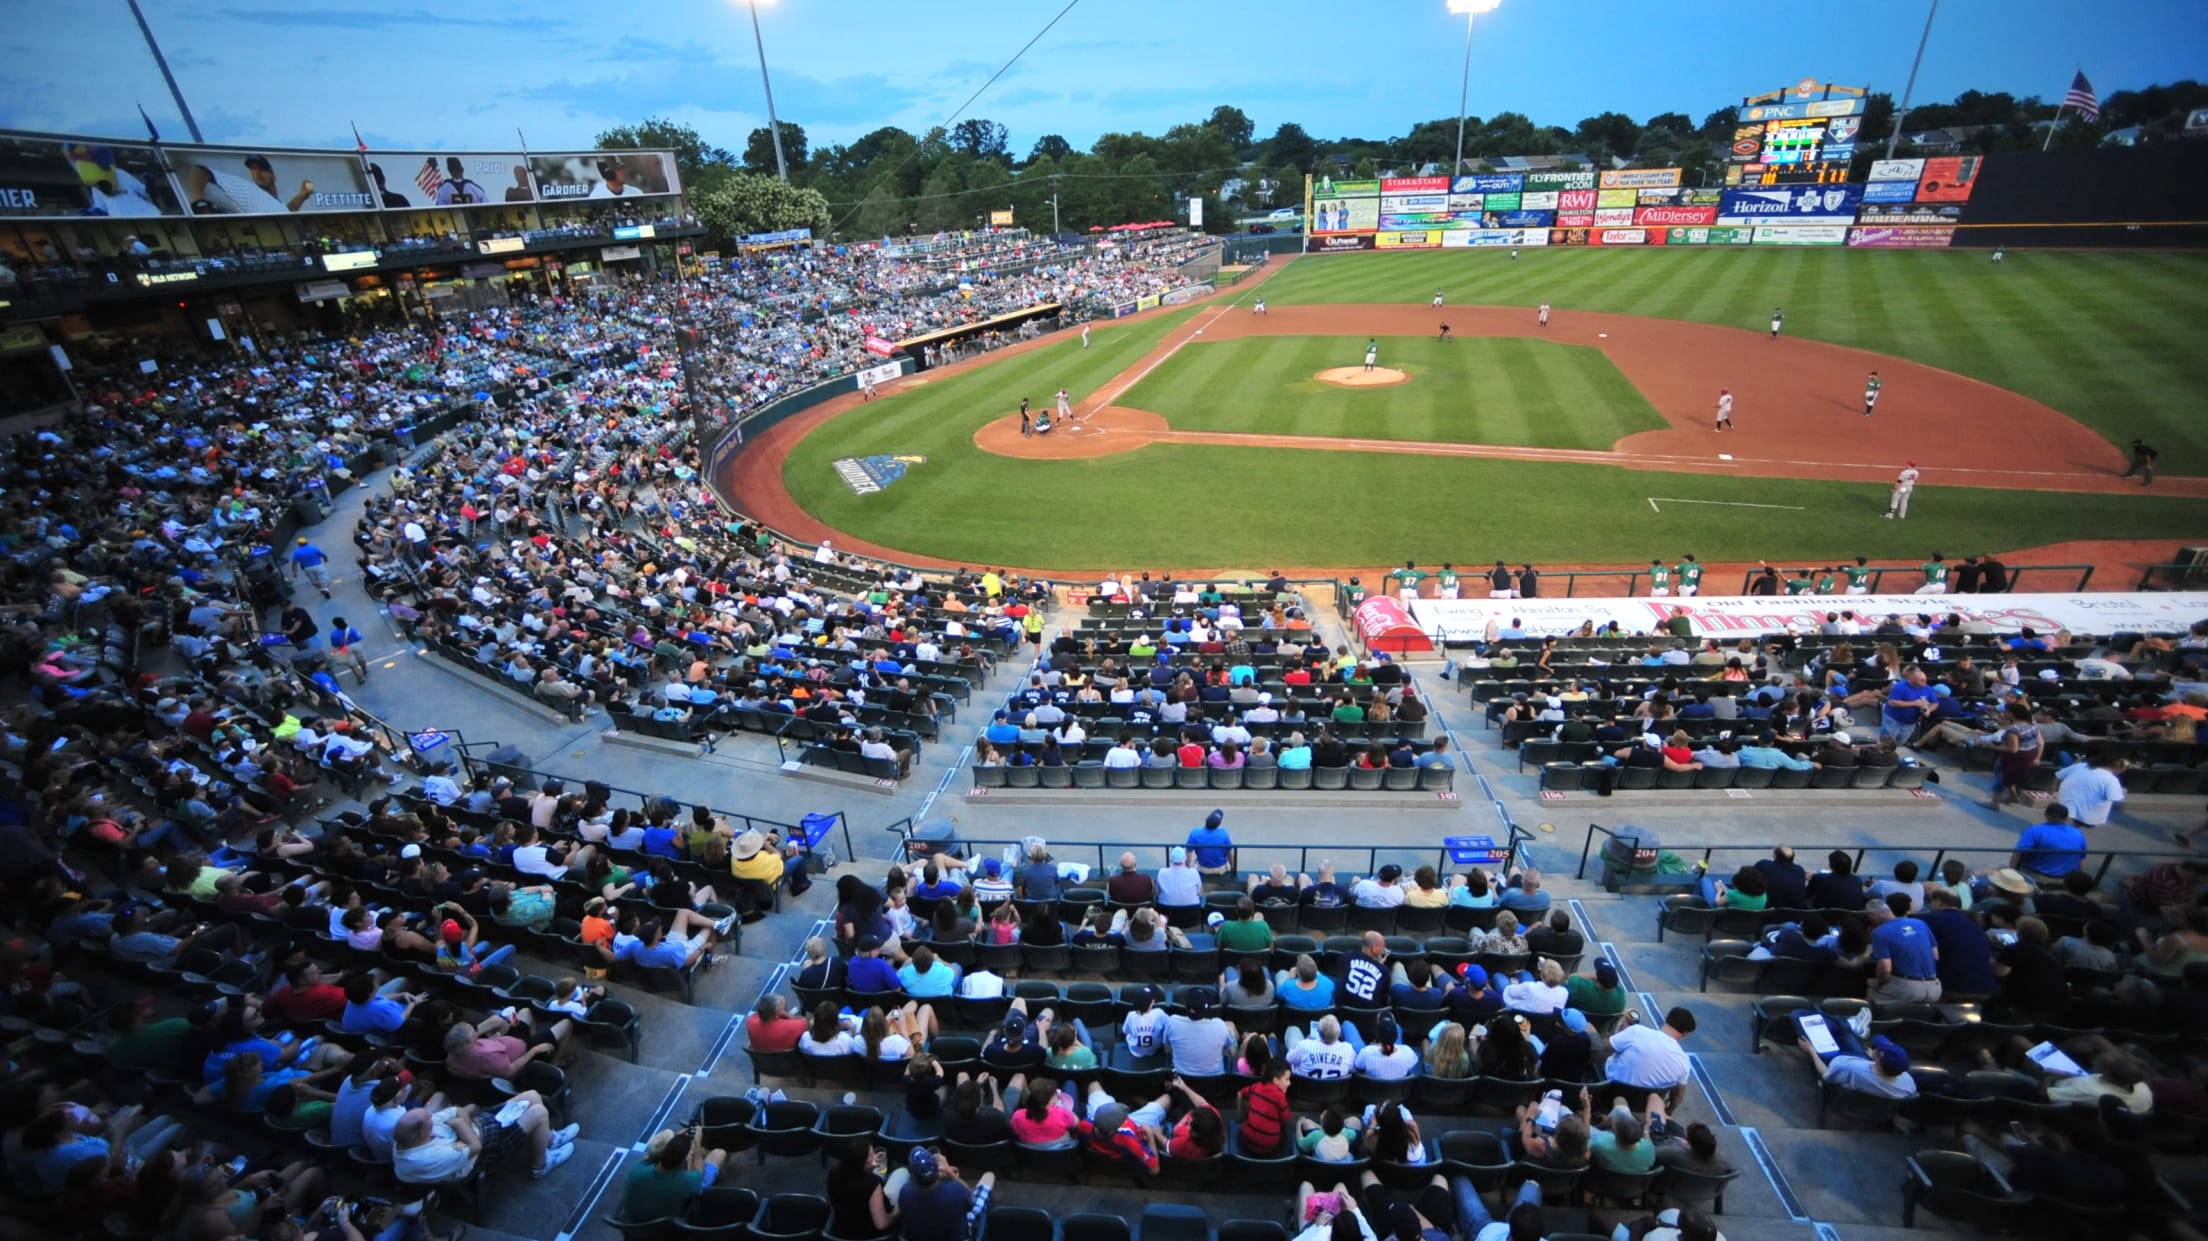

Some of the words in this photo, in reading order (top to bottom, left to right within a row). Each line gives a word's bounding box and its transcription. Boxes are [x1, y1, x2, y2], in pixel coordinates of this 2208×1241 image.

[1764, 106, 1794, 118] PNC
[1529, 172, 1594, 182] FLYFRONTIER
[542, 184, 589, 197] GARDNER
[316, 192, 373, 207] PETTITTE
[1562, 192, 1594, 208] RWJ
[1733, 200, 1789, 213] Horizon
[1596, 209, 1632, 225] Wendy's
[1605, 230, 1627, 241] Taylor
[1755, 597, 1876, 606] Fashioned
[1887, 597, 1954, 606] Style
[1433, 605, 1484, 617] Ewing
[1511, 604, 1580, 614] Hamilton
[1923, 646, 1941, 661] 42
[1439, 791, 1457, 800] 107
[1543, 791, 1564, 800] 106
[908, 841, 928, 850] 205
[1488, 849, 1511, 859] 205
[1635, 848, 1657, 858] 204
[1345, 968, 1377, 1001] 52
[1136, 1035, 1153, 1048] 19
[1310, 1052, 1343, 1067] RIVERA
